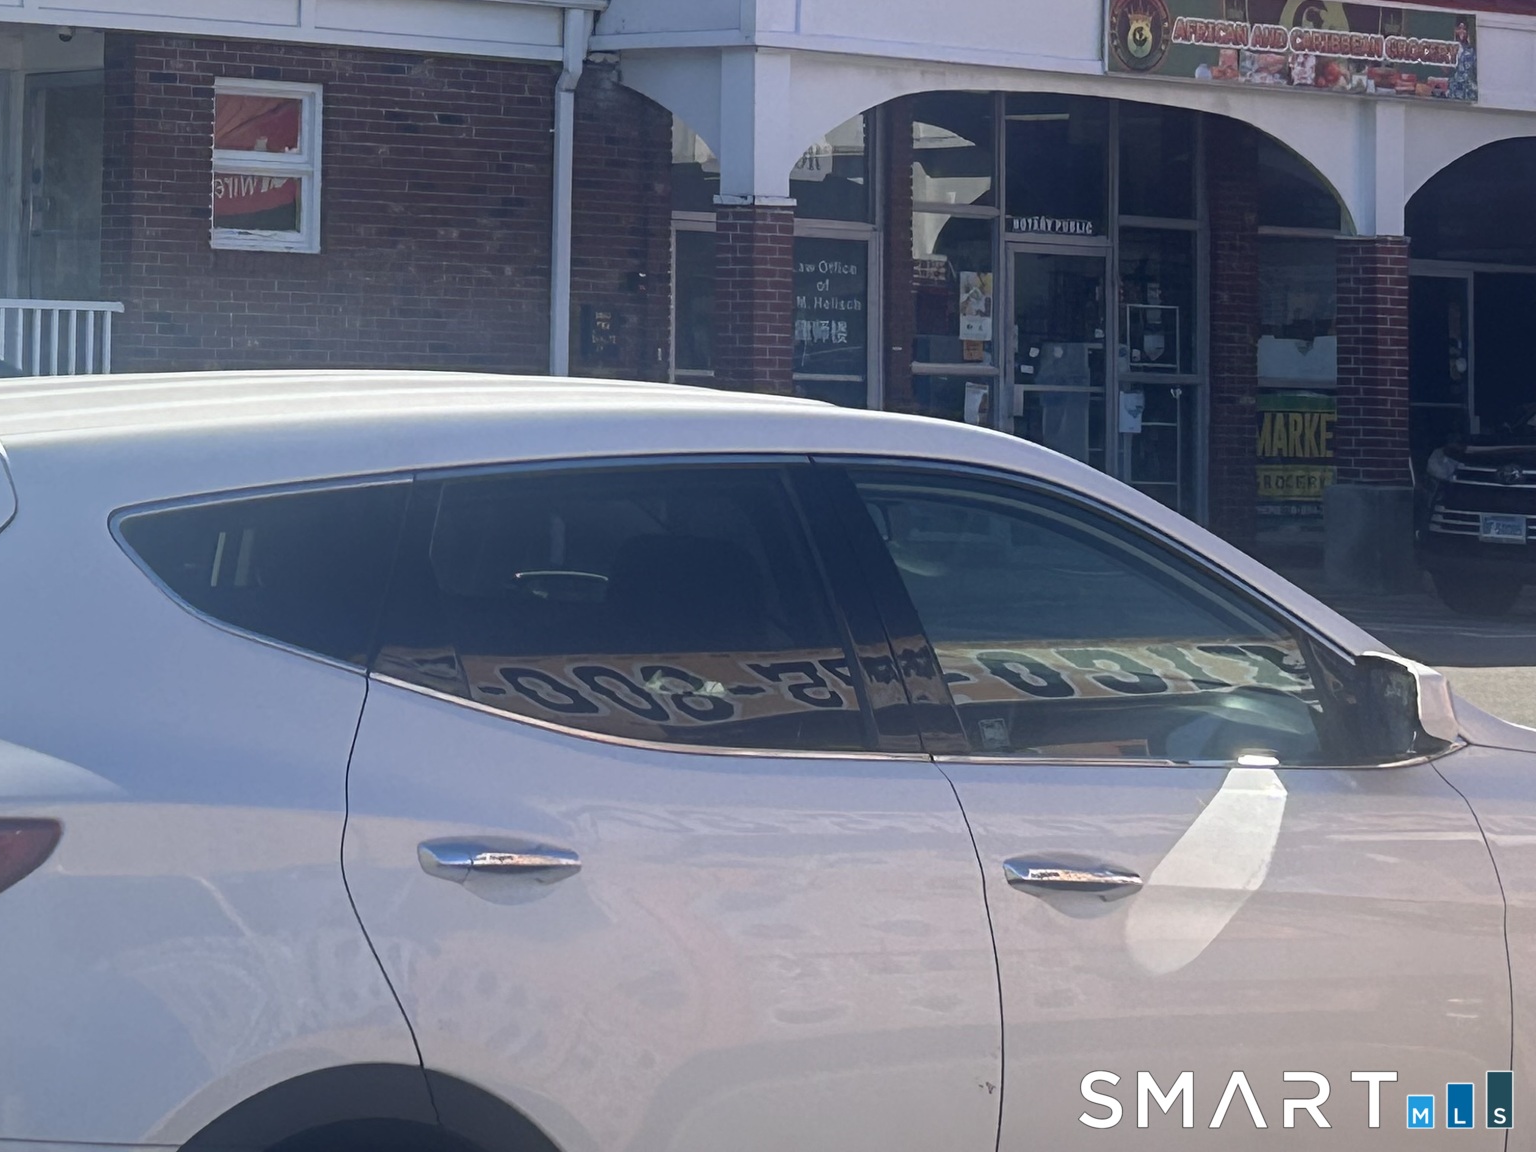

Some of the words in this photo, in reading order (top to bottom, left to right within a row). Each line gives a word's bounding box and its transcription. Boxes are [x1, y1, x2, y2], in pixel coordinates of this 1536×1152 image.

[1173, 16, 1250, 48] AFRICAN
[1251, 24, 1288, 52] AND
[1289, 28, 1384, 60] CARIBBEAN
[1384, 36, 1461, 67] GROCERY
[1056, 219, 1094, 234] PUBLIC
[816, 278, 830, 292] of
